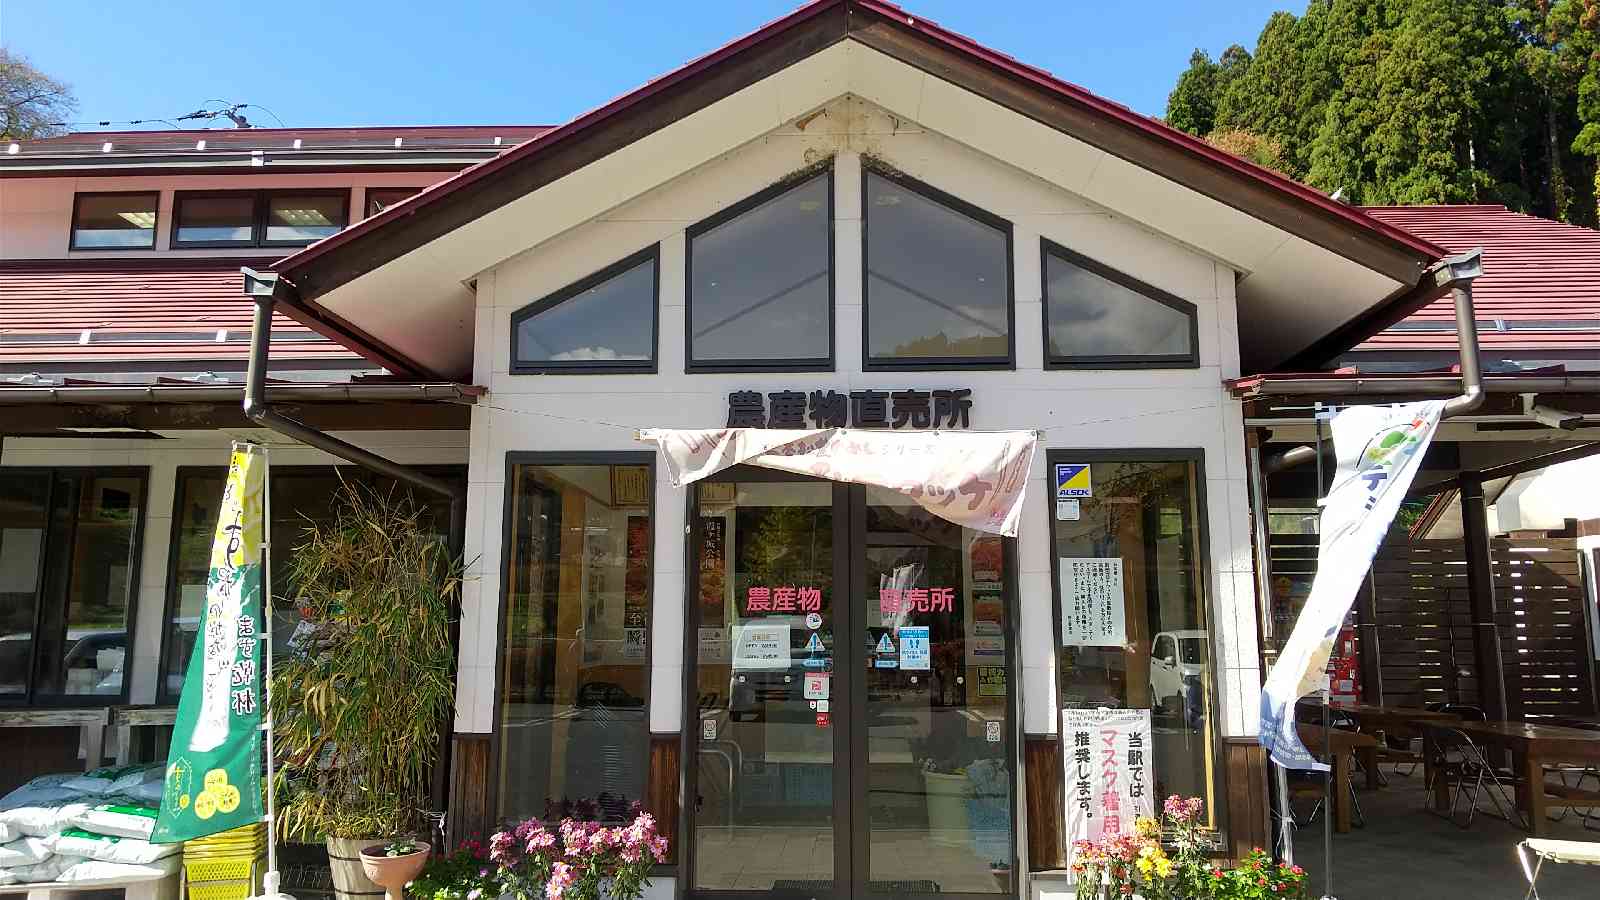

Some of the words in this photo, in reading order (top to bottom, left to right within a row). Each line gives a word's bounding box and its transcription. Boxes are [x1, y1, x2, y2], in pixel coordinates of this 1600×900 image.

[726, 389, 974, 429] 農産物直売所
[746, 586, 822, 612] 農産物
[880, 587, 955, 613] 直売所
[1074, 731, 1093, 818] 推奨します。
[1100, 729, 1120, 833] マスク着用
[1128, 732, 1144, 798] 当駅では
